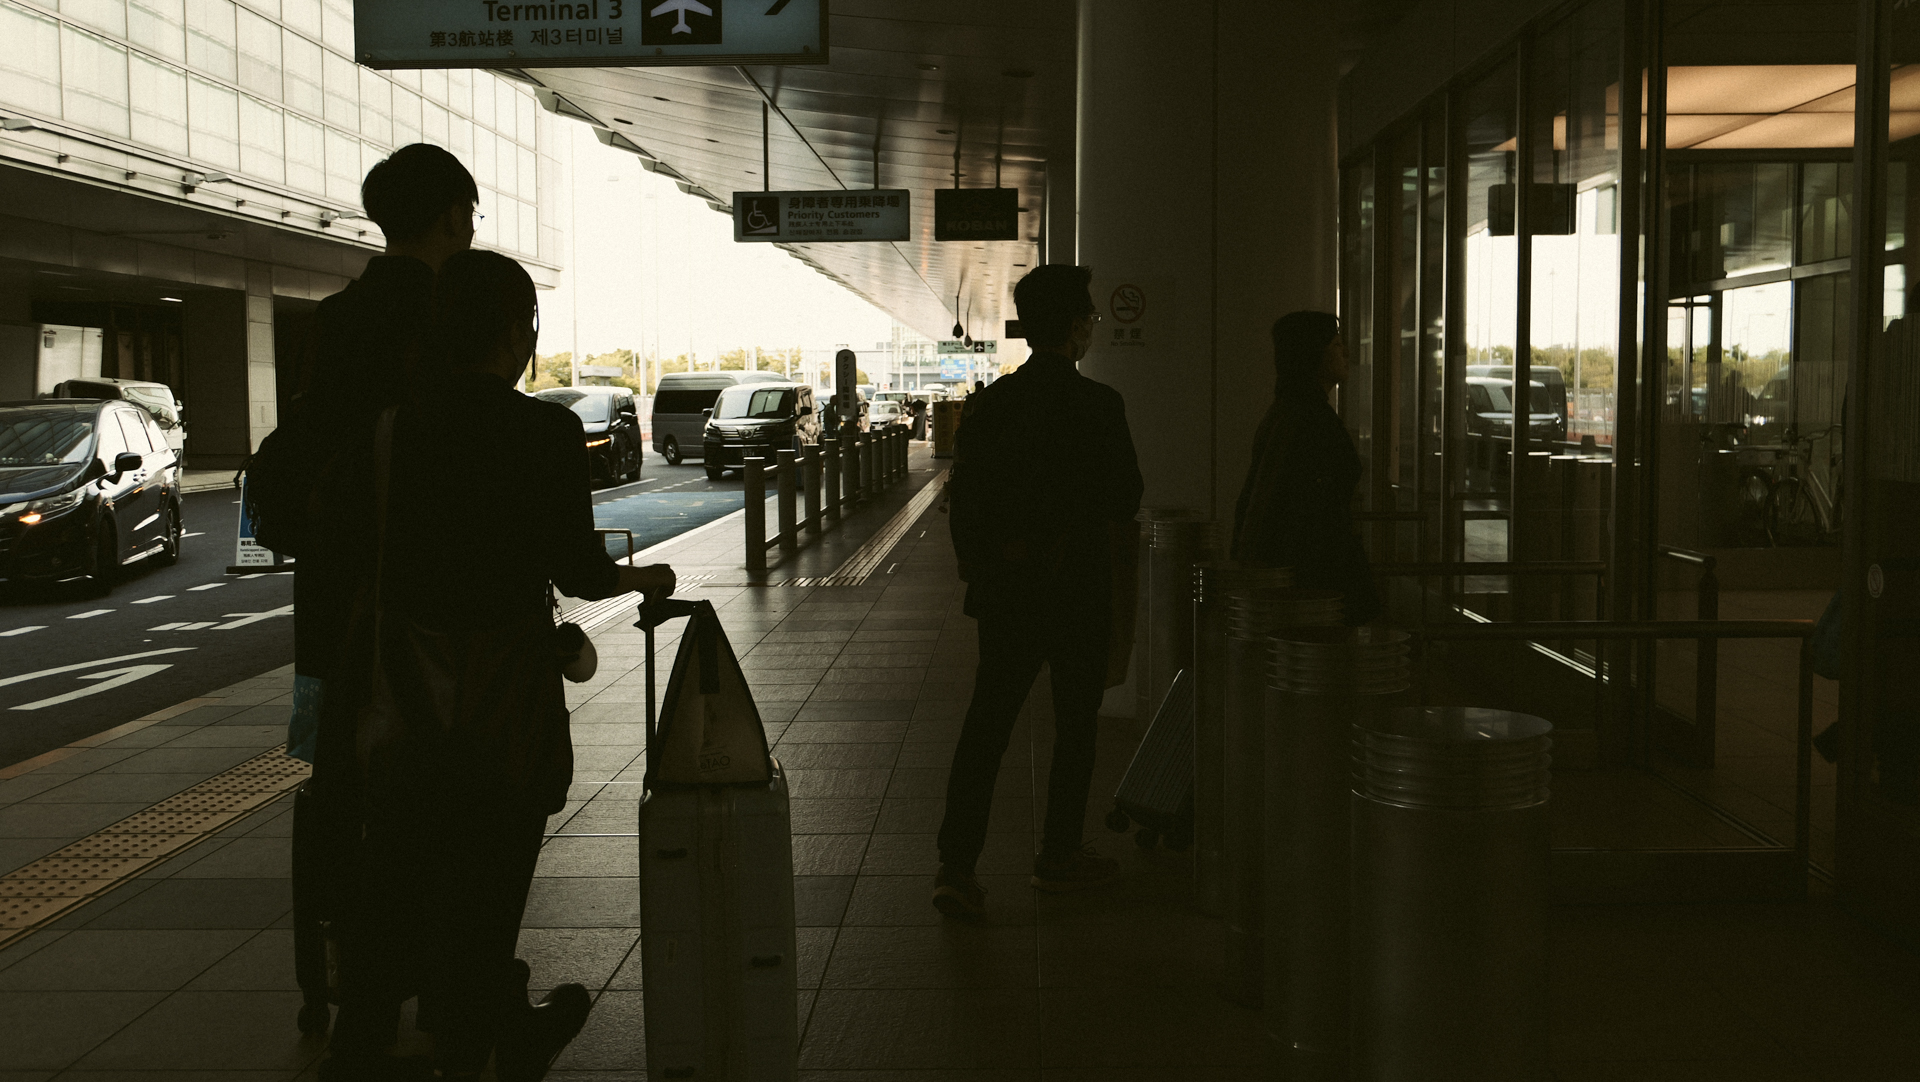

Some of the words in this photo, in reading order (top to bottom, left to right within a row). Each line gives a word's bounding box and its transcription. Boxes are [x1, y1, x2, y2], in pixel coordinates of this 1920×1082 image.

[483, 0, 598, 21] Terminal
[608, 0, 623, 20] 3
[429, 30, 514, 48] 第3航站楼
[530, 26, 624, 45] 제3터미널
[788, 210, 825, 221] Priority
[828, 210, 880, 219] Customers
[945, 220, 1008, 232] KOBAN
[1114, 328, 1142, 339] 禁煙
